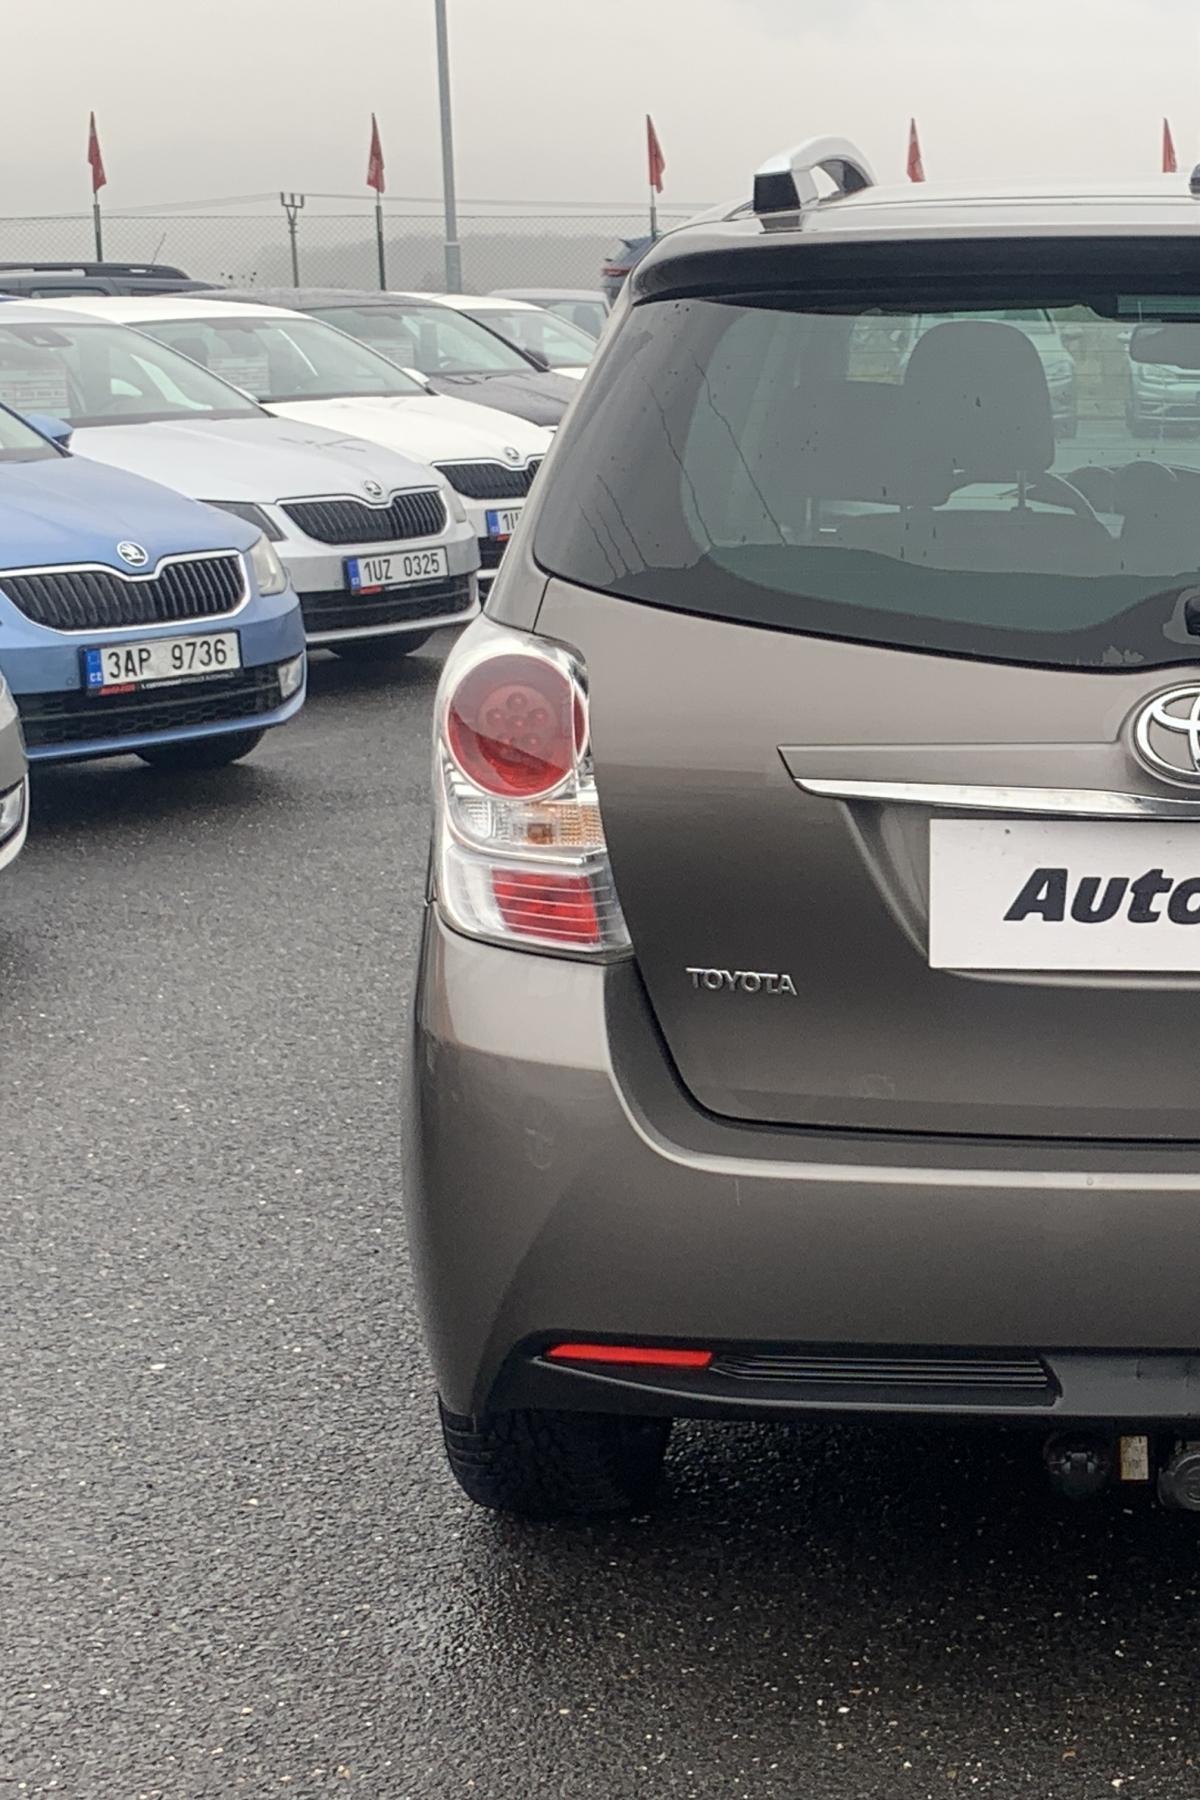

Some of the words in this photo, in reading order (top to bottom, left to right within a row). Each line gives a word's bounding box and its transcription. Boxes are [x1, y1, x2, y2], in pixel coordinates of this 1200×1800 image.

[502, 512, 521, 531] 1U
[363, 558, 393, 582] 1UZ
[403, 552, 440, 577] 0325
[108, 648, 152, 679] 3AP
[171, 638, 227, 670] 9736
[685, 967, 798, 996] TOYOTA
